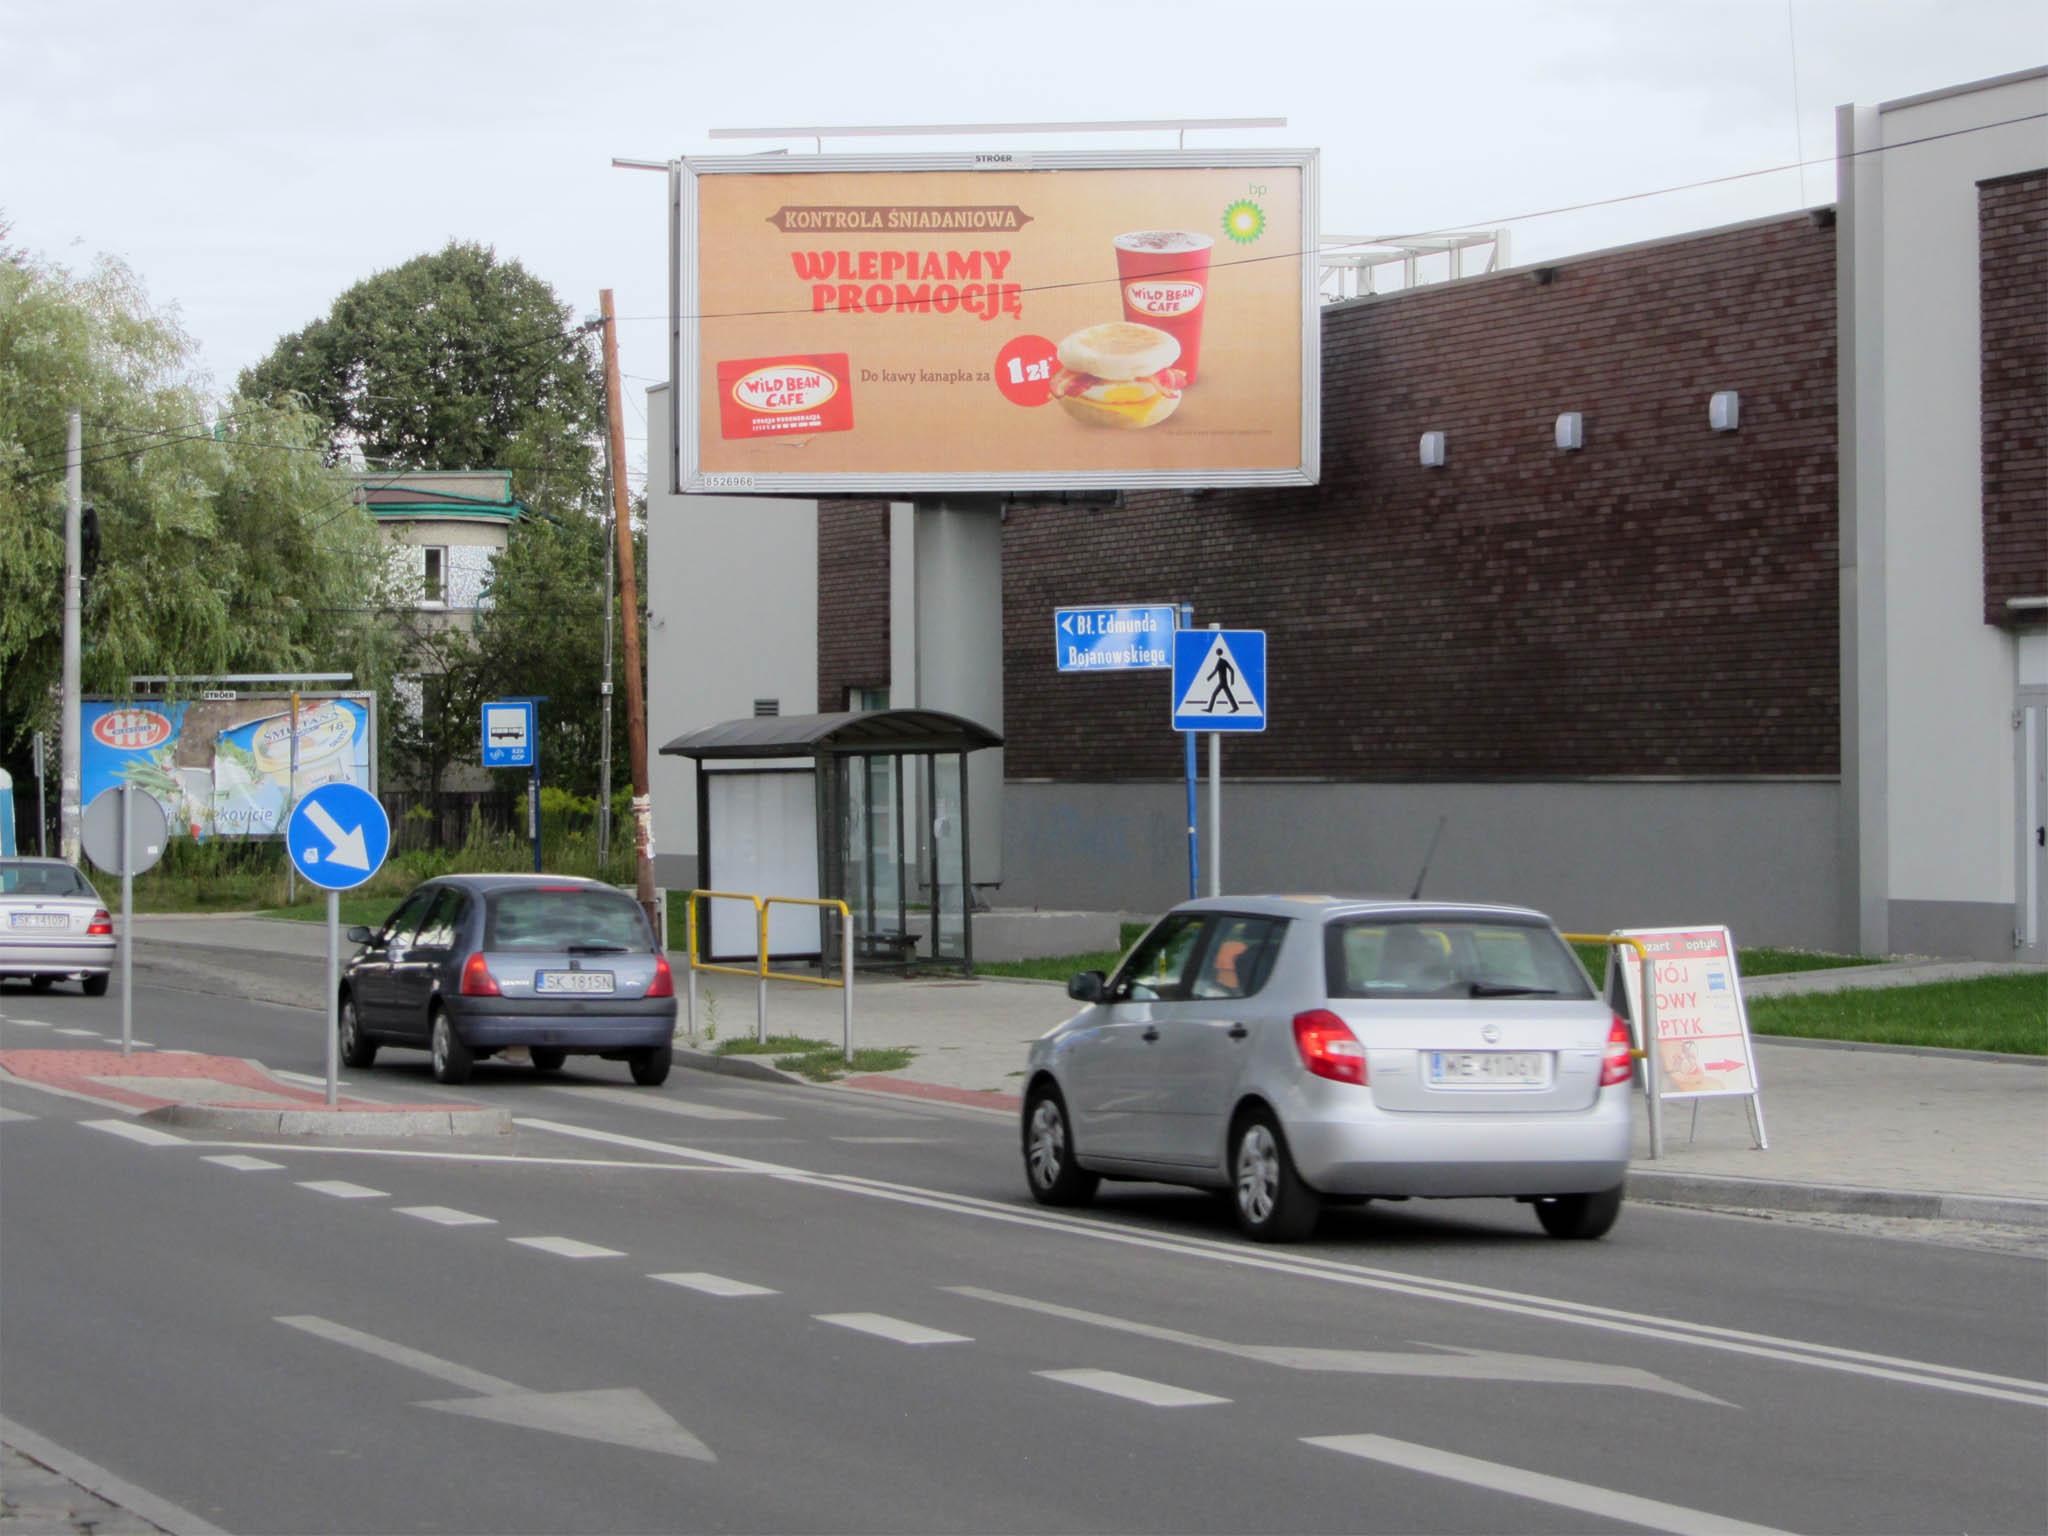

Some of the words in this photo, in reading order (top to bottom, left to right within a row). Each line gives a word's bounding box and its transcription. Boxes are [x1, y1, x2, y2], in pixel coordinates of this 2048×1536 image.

[1248, 182, 1268, 197] bp
[785, 210, 884, 229] KONTROLA
[887, 207, 1017, 228] ŚNIADANIOWA
[791, 250, 1012, 281] WLEPIAMY
[812, 282, 1023, 321] PROMOCJĘ
[1166, 286, 1195, 302] BEAN
[1146, 301, 1181, 313] CAFE
[860, 369, 879, 383] Do
[882, 368, 917, 385] kawy
[920, 368, 973, 385] kanapka
[976, 371, 991, 383] za
[1007, 357, 1025, 385] 1
[785, 375, 821, 393] BEAN
[765, 392, 805, 408] CAFE
[1077, 615, 1096, 635] Bł.
[1097, 612, 1158, 635] Edmunda
[1068, 643, 1166, 667] Bojanowskiego
[1686, 937, 1719, 952] optyk
[546, 975, 565, 990] SK
[1655, 991, 1697, 1010] OWY
[1656, 1018, 1704, 1037] PTYK
